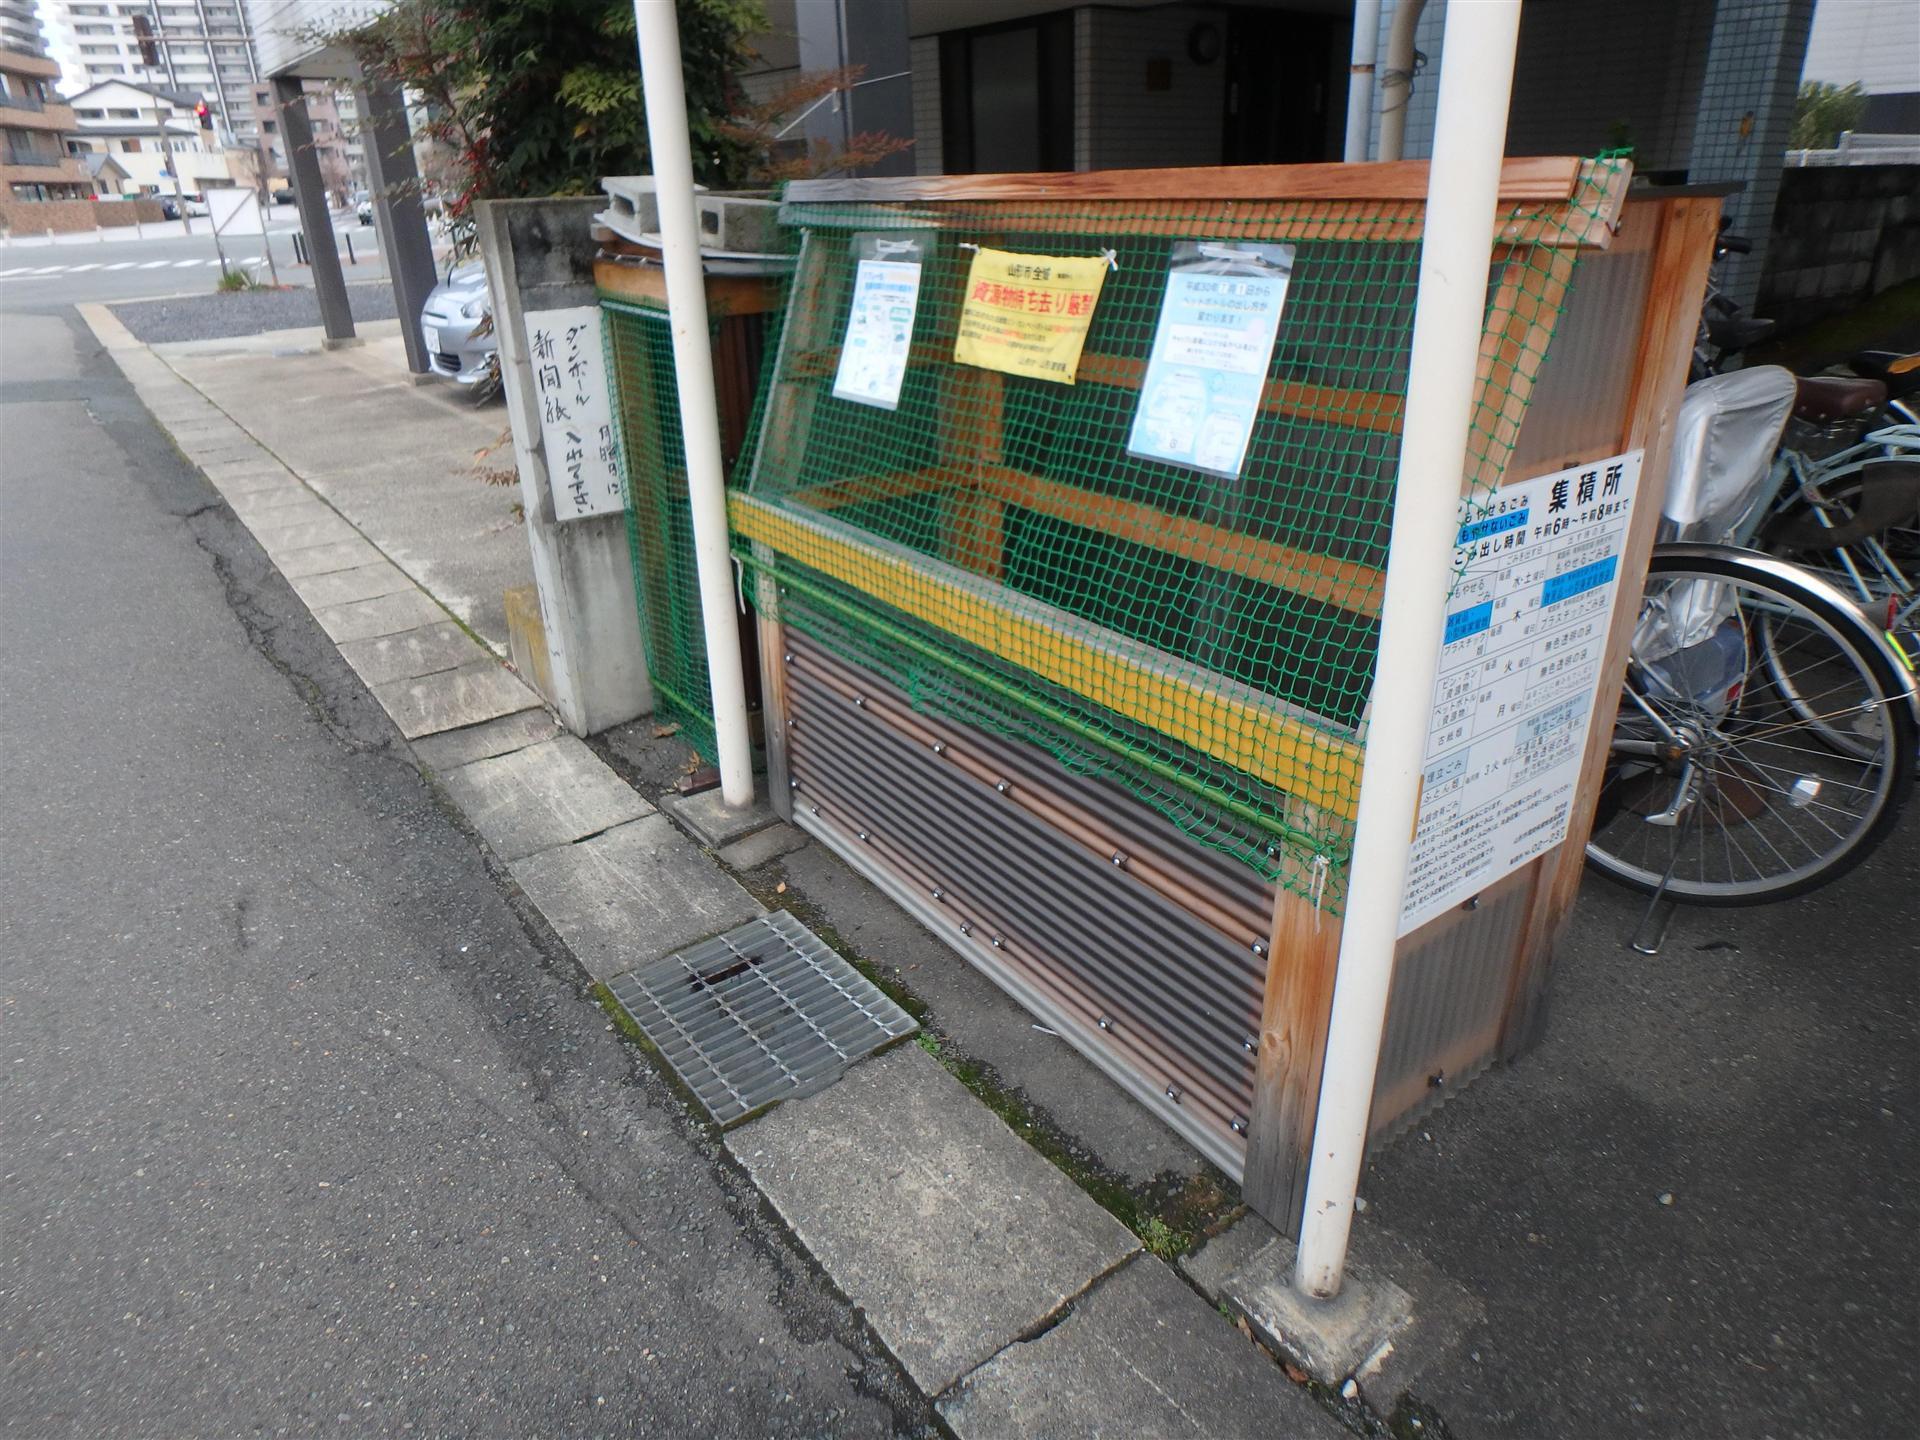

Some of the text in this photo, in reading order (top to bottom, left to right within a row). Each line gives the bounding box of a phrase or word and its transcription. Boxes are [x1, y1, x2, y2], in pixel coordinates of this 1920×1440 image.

[972, 281, 1093, 316] 資源物持ち去り厳禁
[532, 329, 571, 423] 新聞紙
[566, 324, 591, 406] ダンボール
[1547, 463, 1623, 515] 集積所
[1454, 529, 1526, 566] ごみ出し時間
[1454, 578, 1485, 598] もやせる
[1475, 589, 1491, 604] ごみ
[1503, 658, 1513, 673] 火
[1496, 702, 1505, 718] 月
